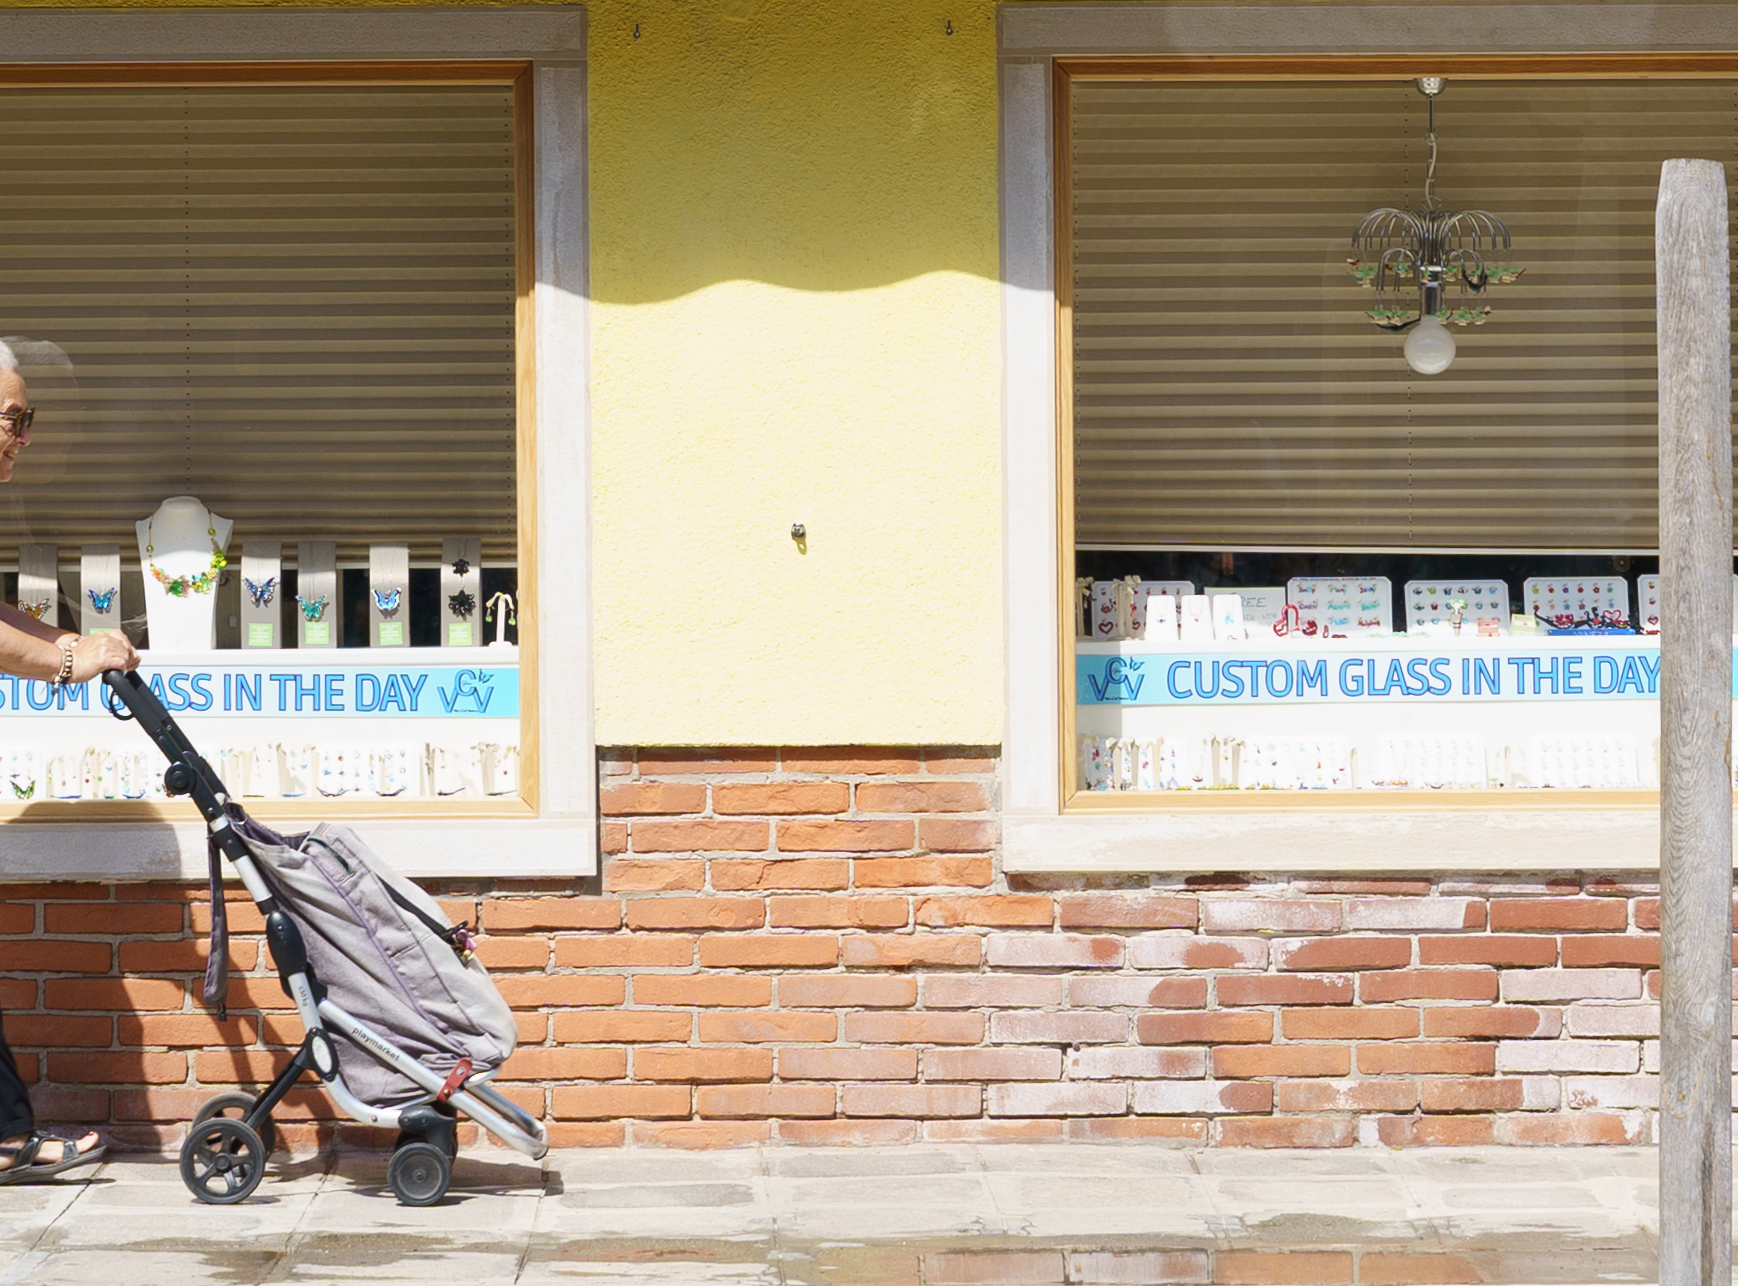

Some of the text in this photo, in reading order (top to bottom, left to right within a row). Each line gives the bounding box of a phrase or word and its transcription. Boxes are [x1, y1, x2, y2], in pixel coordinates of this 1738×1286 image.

[222, 673, 262, 712] IN
[269, 673, 346, 712] THE
[355, 673, 429, 712] DAY
[1166, 655, 1661, 699] CUSTOM GLASS IN THE DAY
[352, 1027, 401, 1062] playmarket
